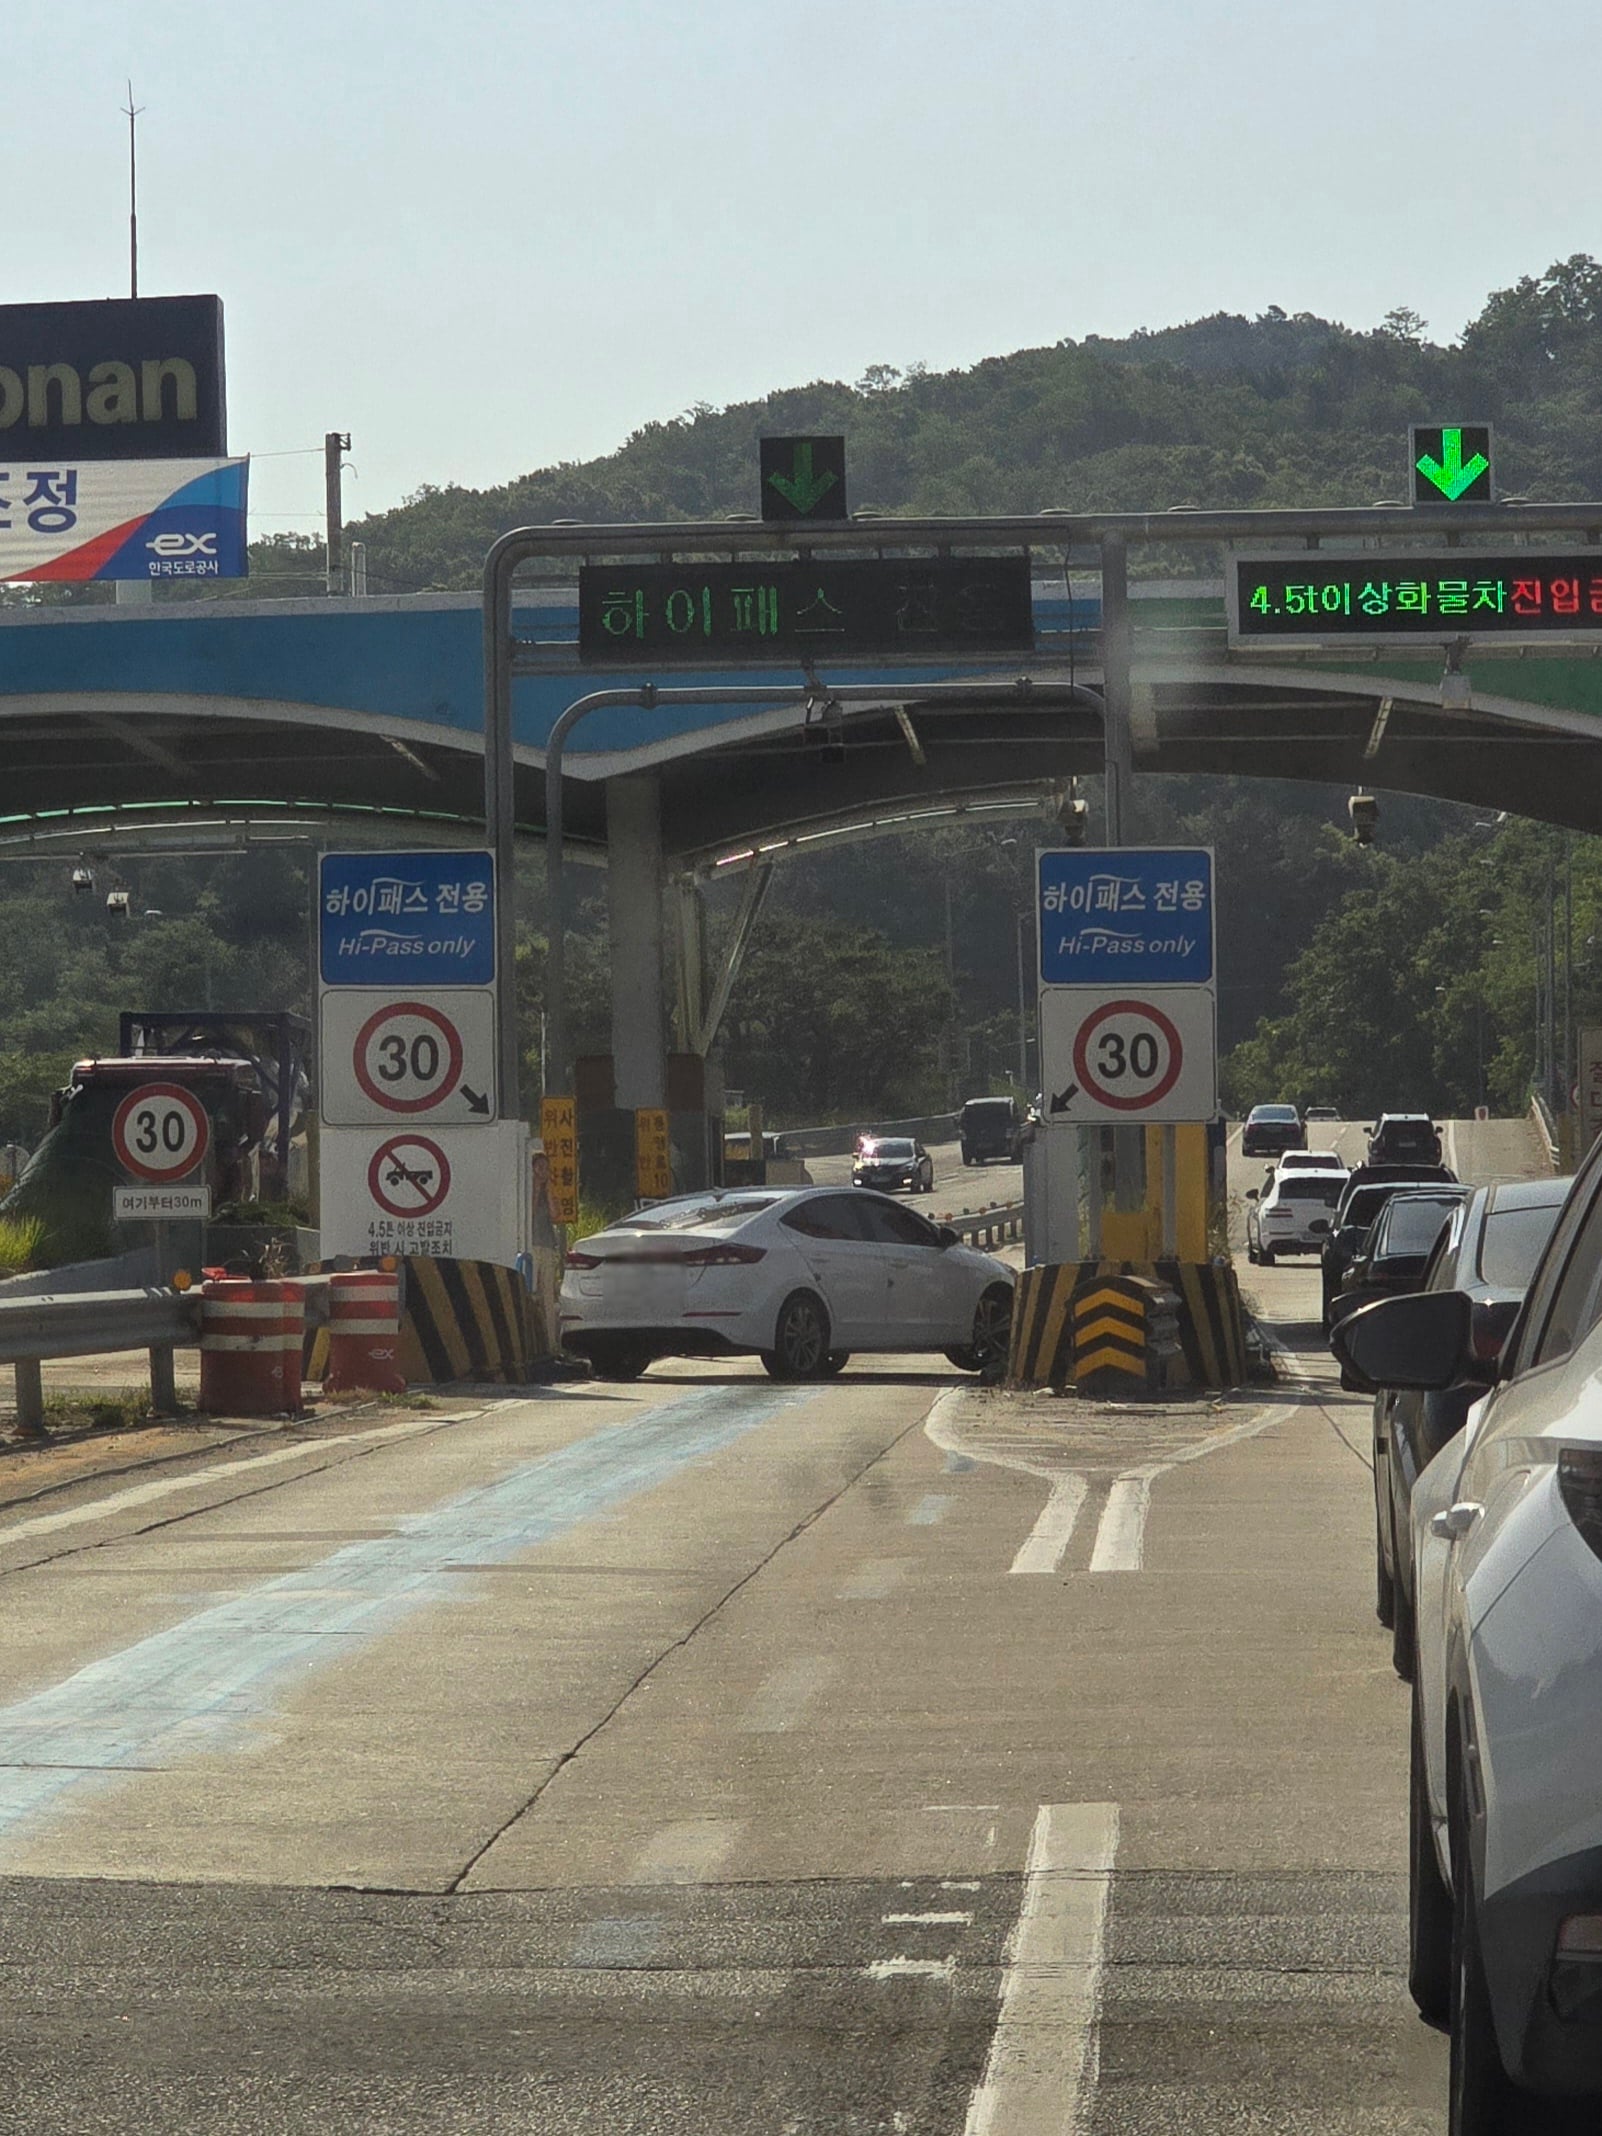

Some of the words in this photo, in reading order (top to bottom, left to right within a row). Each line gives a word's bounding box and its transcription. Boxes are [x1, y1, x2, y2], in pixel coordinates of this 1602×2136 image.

[0, 469, 78, 533] 정
[148, 560, 219, 576] 한국도로공사
[327, 877, 429, 916] 하이패스
[437, 881, 488, 914] 전용
[1043, 877, 1146, 913] 하이패스
[1153, 880, 1206, 912] 전용
[338, 935, 425, 957] Hi-Pass
[428, 936, 476, 959] only
[1058, 934, 1145, 955] Hi-Pass
[1148, 935, 1196, 957] only
[378, 1035, 440, 1082] 30
[1097, 1033, 1160, 1079] 30
[136, 1110, 185, 1153] 30
[122, 1196, 202, 1210] 여기부터30m
[397, 1221, 415, 1237] 이상
[417, 1220, 453, 1236] 진입금지
